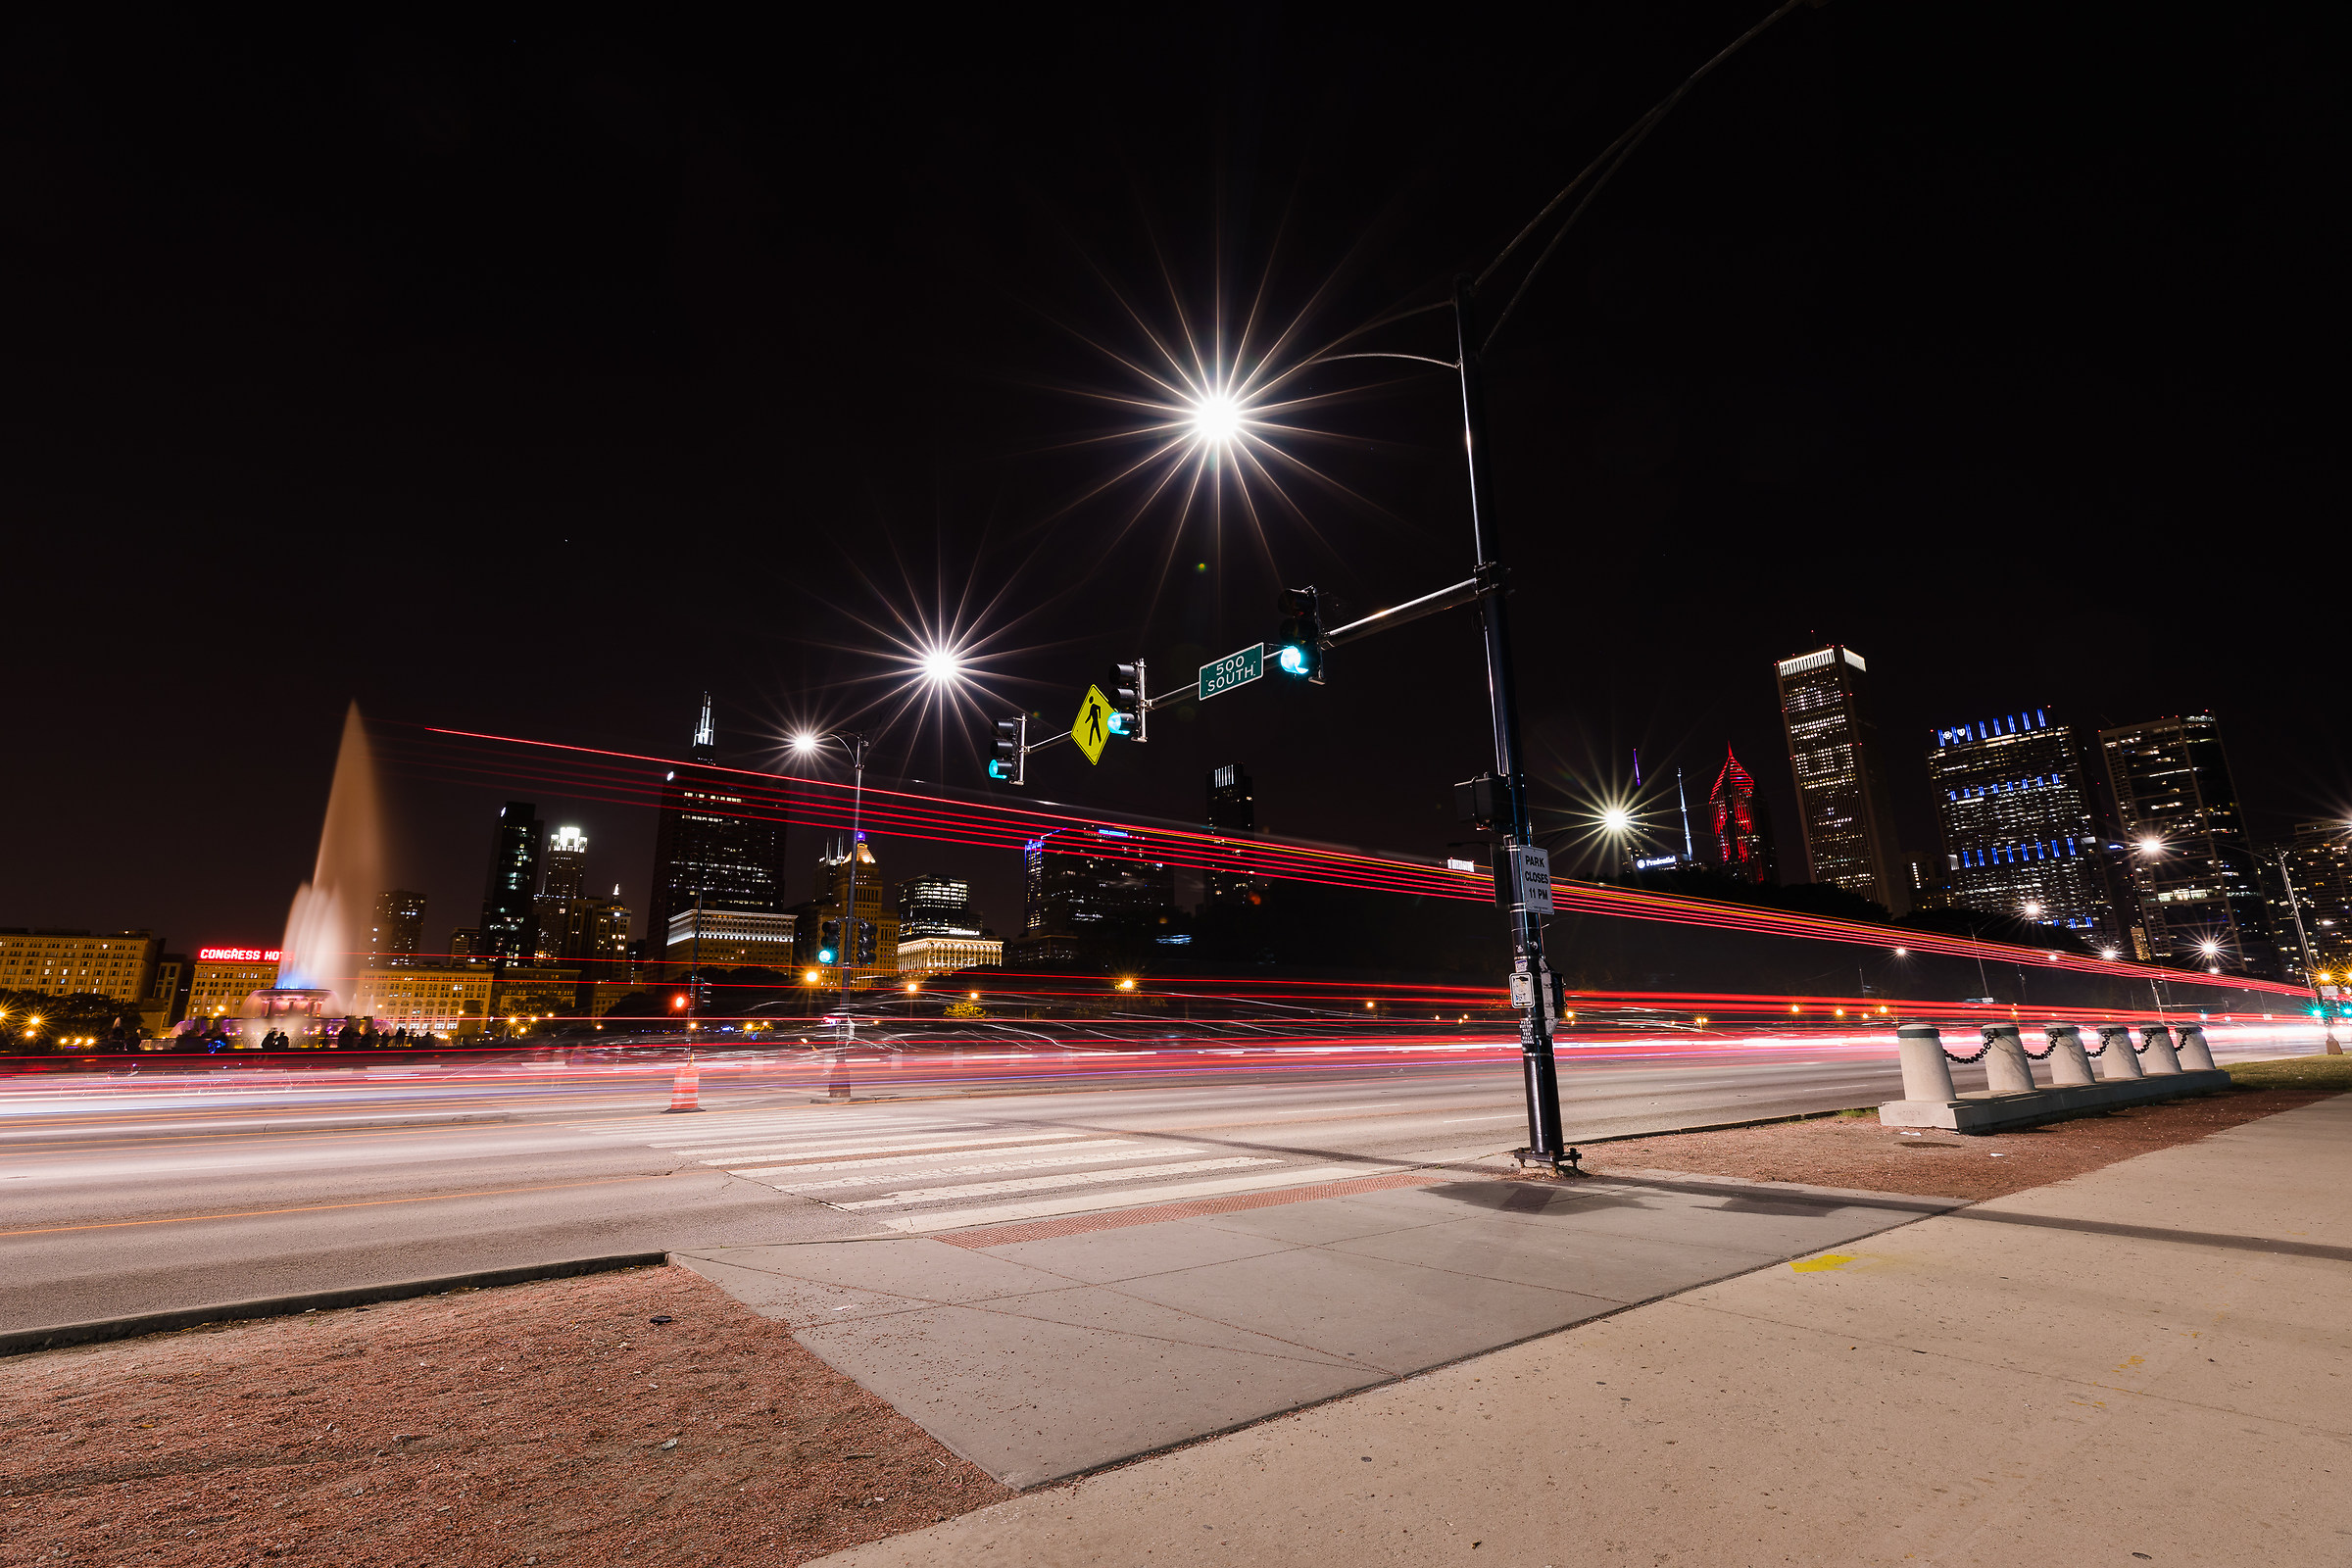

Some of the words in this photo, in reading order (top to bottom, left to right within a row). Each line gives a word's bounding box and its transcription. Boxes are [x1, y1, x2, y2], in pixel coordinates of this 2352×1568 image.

[1216, 656, 1245, 675] 500
[1207, 663, 1253, 692] SOUTH
[1525, 855, 1544, 867] PARK
[1525, 870, 1548, 884] CLOSES
[1529, 887, 1536, 899] 11
[1538, 888, 1547, 900] PM
[200, 948, 261, 960] CONGRESS
